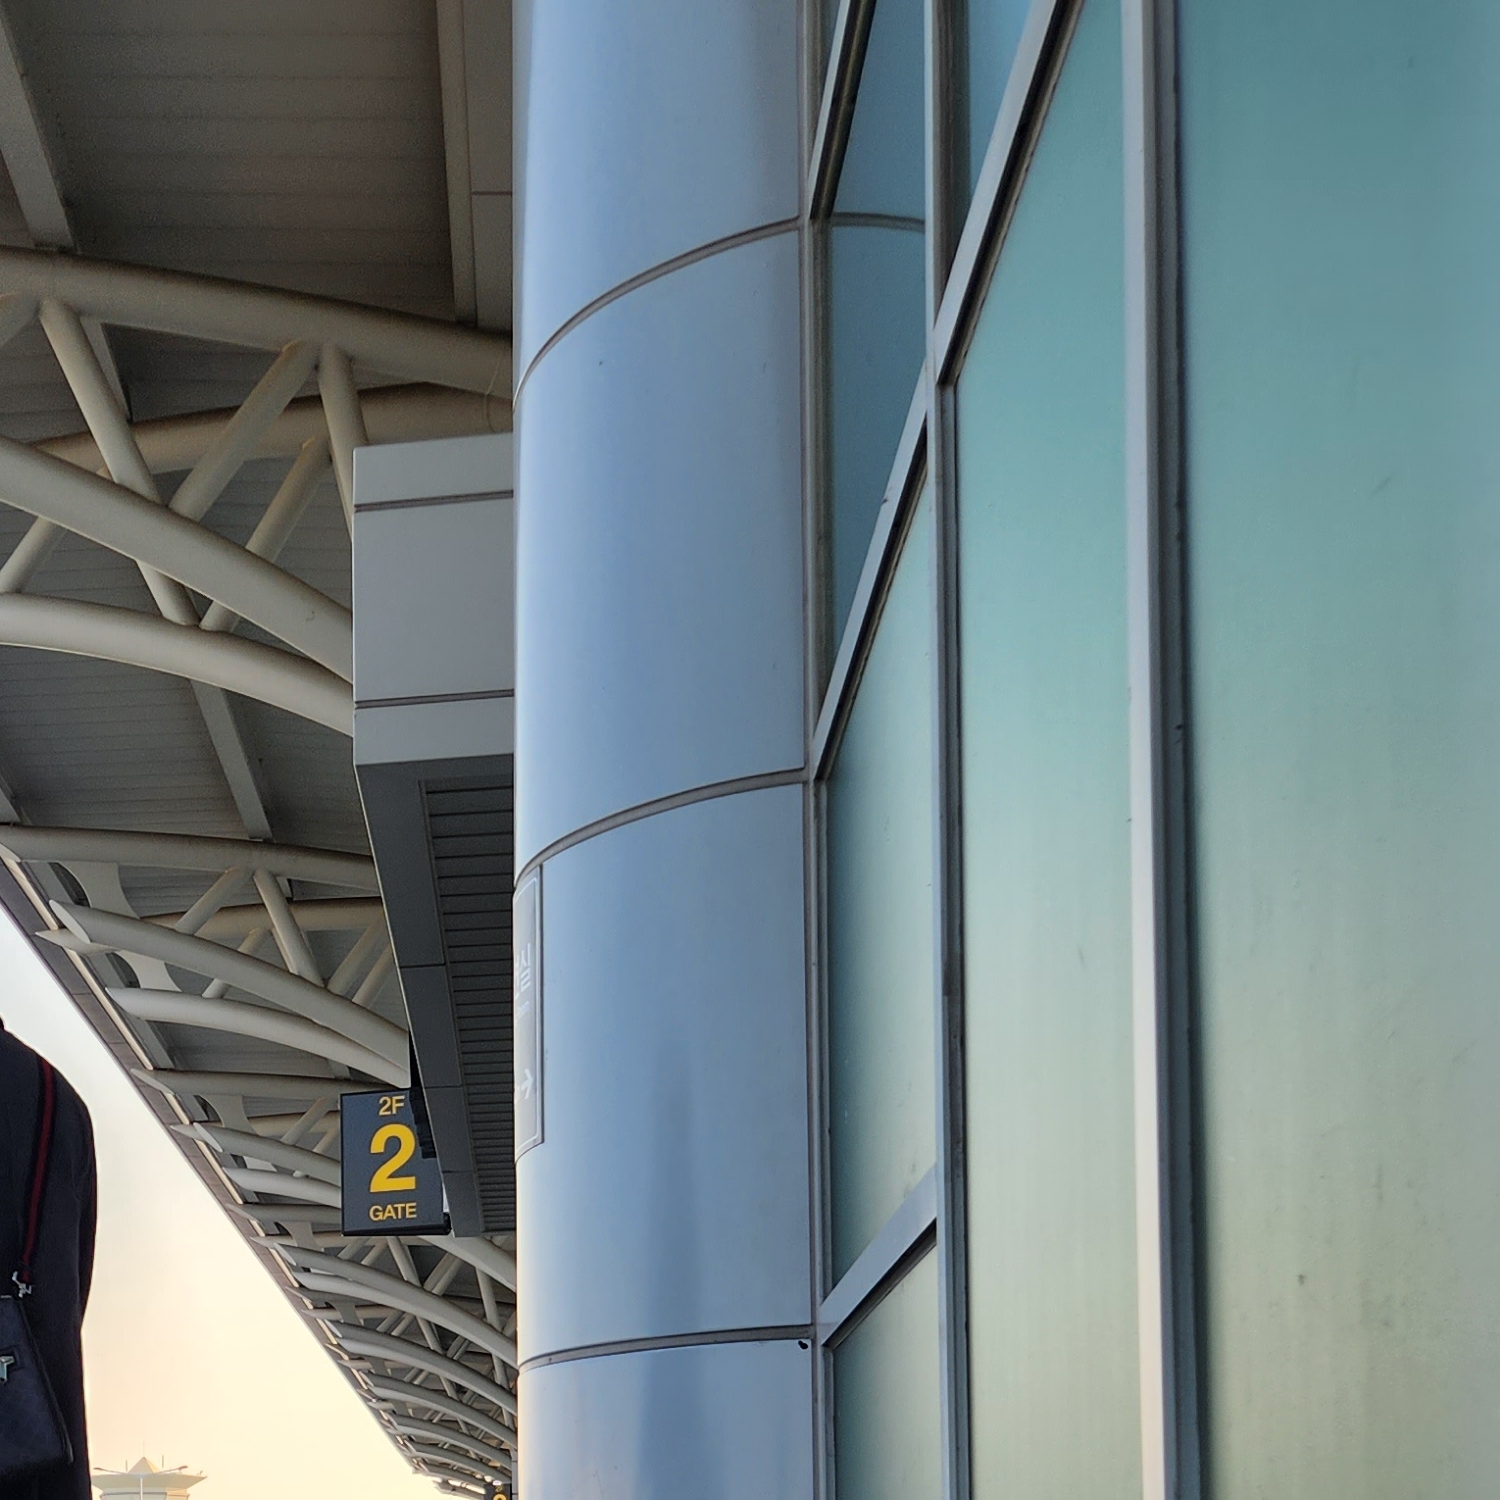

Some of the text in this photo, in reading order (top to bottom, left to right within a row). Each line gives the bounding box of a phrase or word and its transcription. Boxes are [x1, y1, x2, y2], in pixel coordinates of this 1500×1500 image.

[378, 1095, 405, 1116] 2F
[369, 1123, 417, 1193] 2
[368, 1202, 417, 1221] GATE
